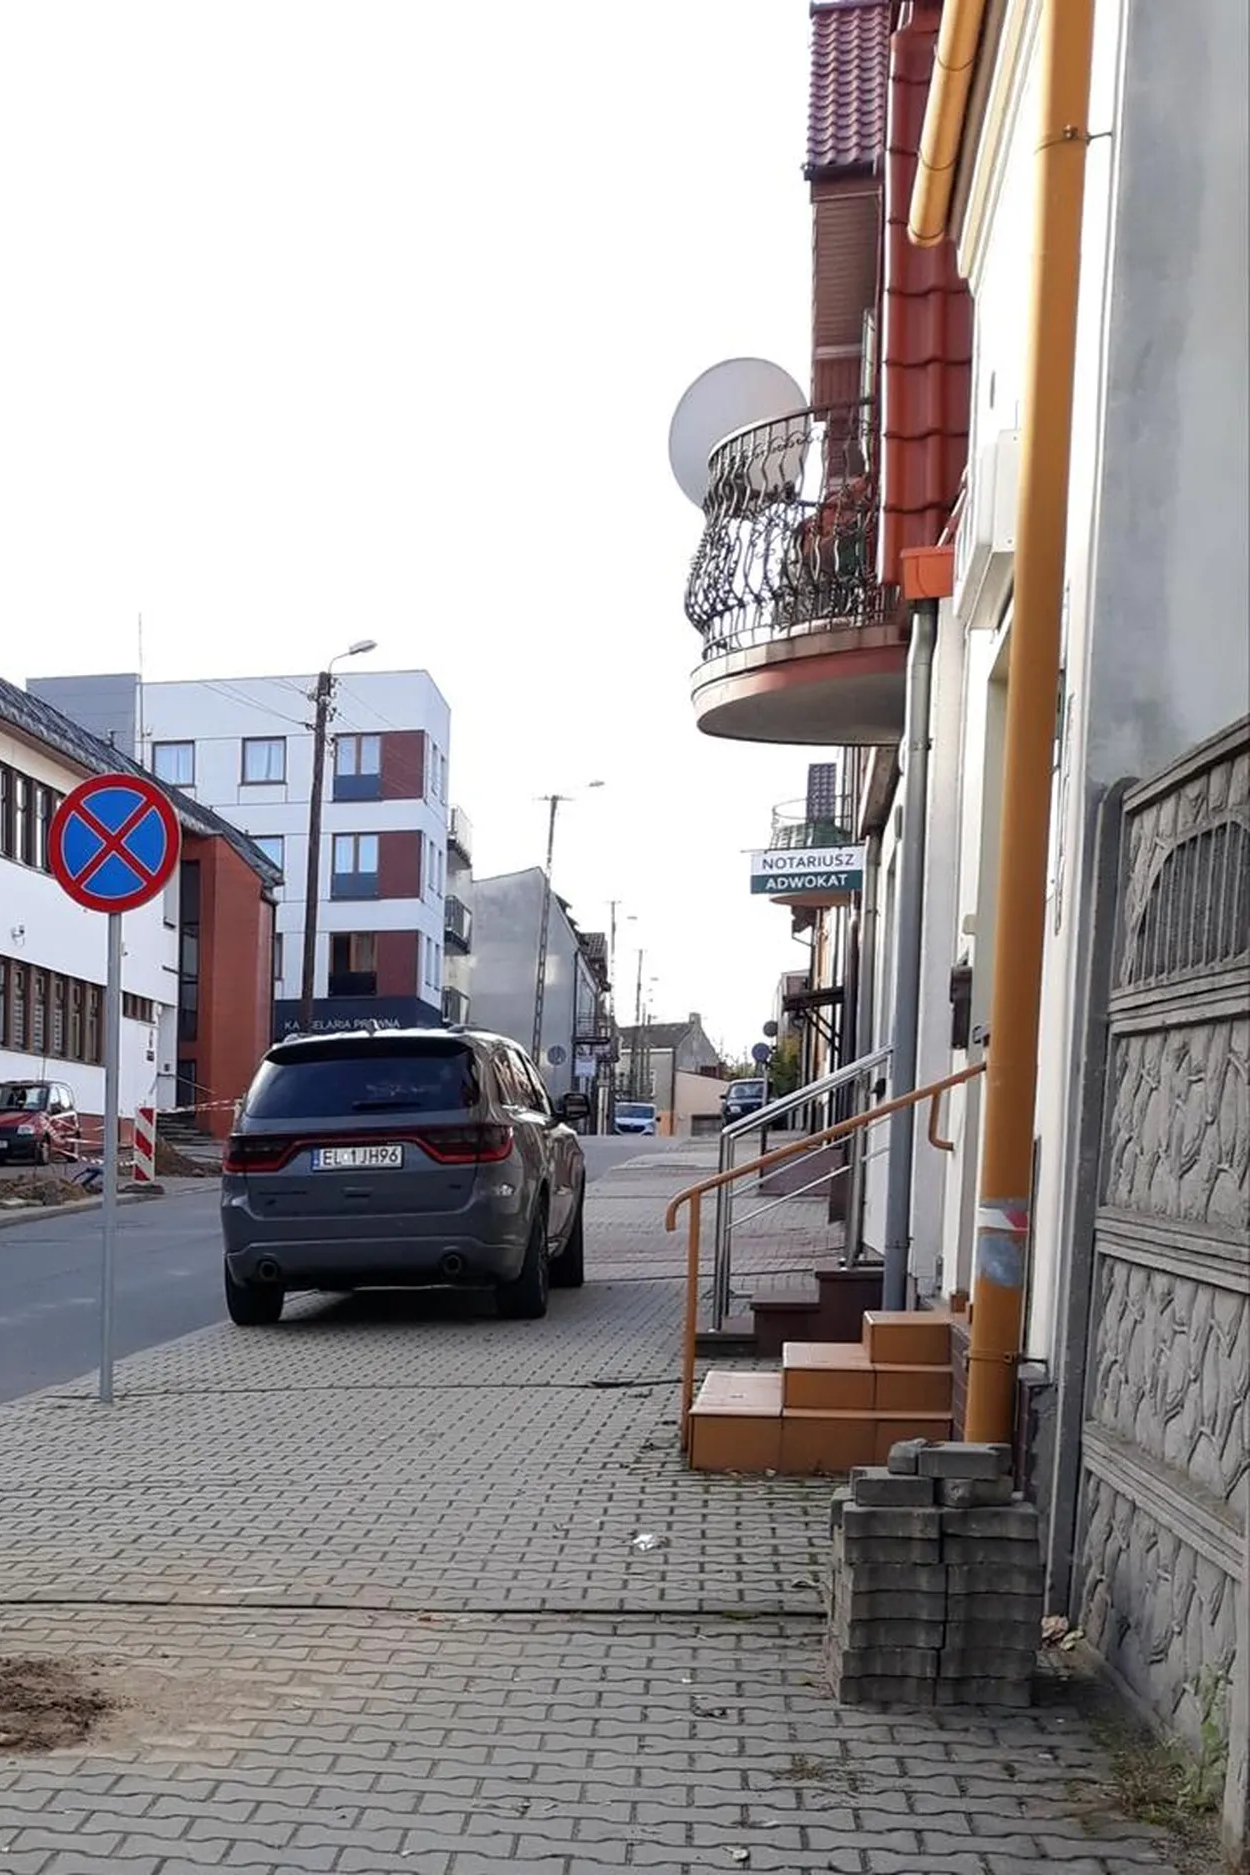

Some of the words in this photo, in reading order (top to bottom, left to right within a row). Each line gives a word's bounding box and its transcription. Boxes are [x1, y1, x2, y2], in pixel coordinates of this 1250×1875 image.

[762, 853, 855, 870] NOTARIUSZ
[765, 873, 848, 890] ADWOKAT
[284, 1019, 351, 1030] KAELARIA
